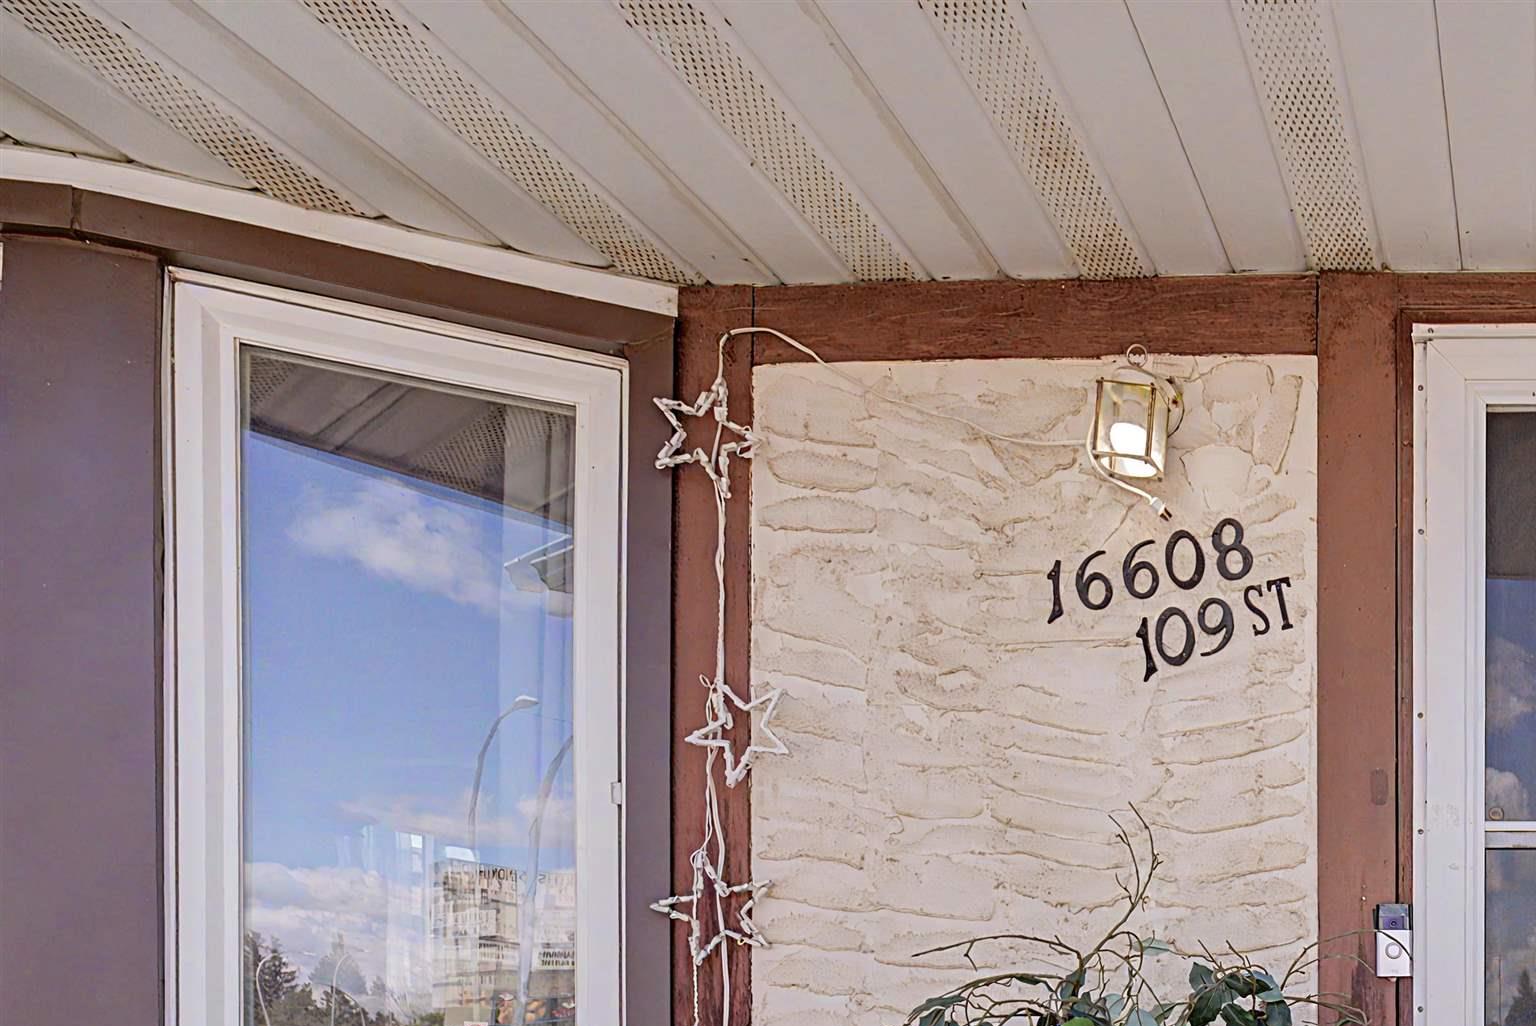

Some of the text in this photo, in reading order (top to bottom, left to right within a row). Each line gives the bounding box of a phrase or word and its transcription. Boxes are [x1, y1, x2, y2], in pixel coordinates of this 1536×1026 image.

[1047, 517, 1253, 624] 16608
[1136, 577, 1293, 682] 109 ST
